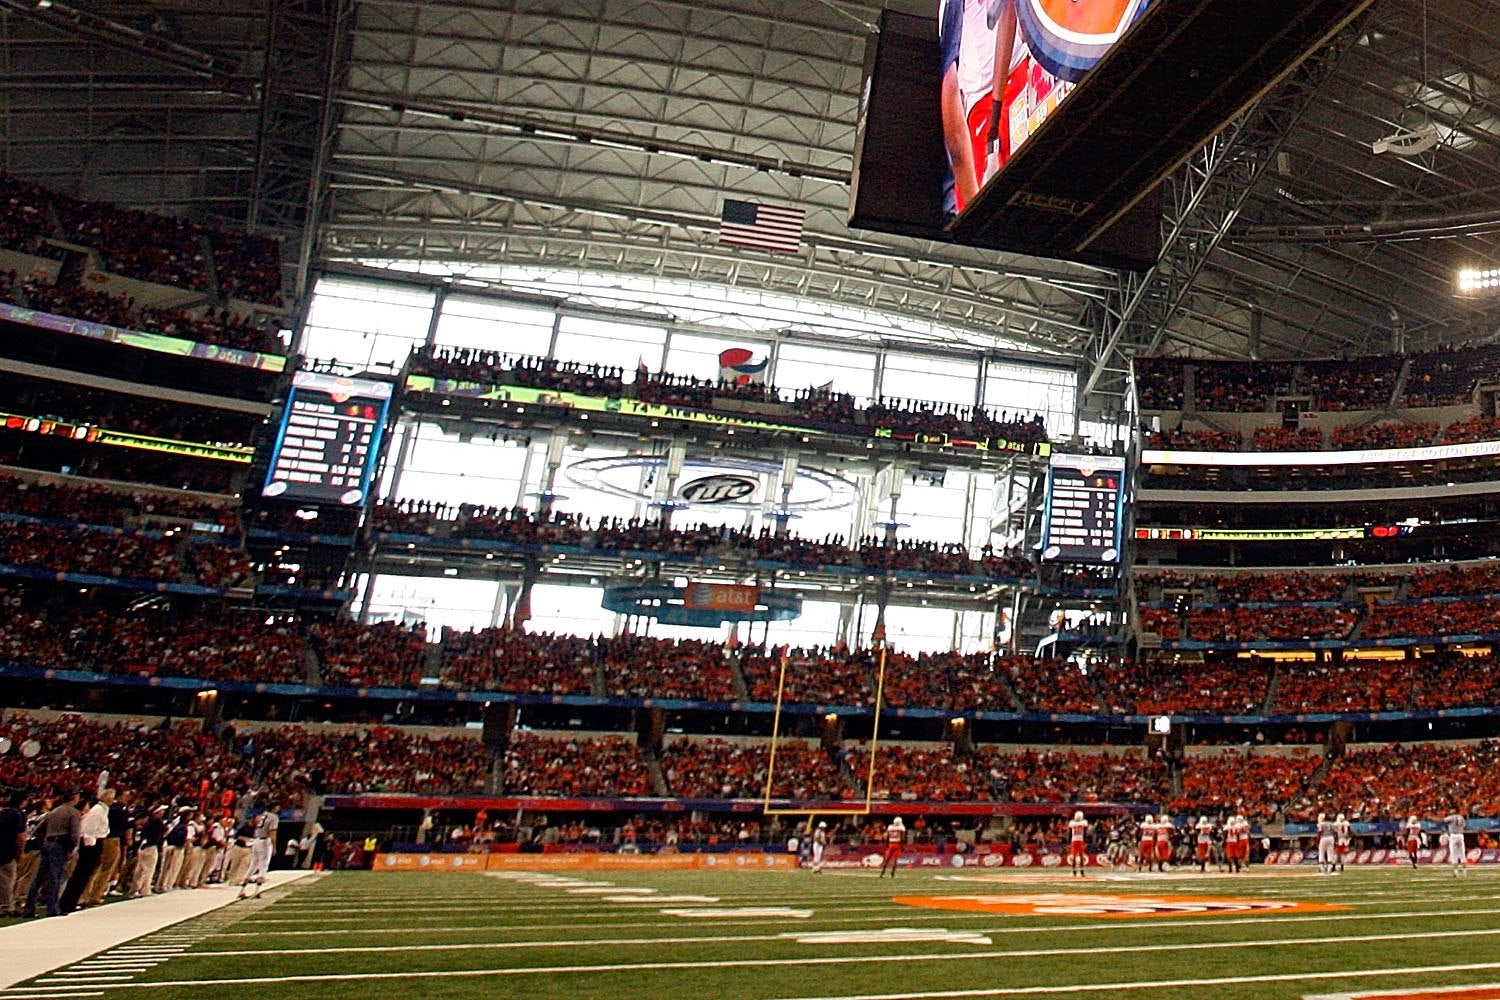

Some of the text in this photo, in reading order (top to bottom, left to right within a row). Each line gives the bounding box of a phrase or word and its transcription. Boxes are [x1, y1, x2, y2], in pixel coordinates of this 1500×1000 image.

[1006, 440, 1025, 452] at&t
[1419, 446, 1470, 459] COTTON
[716, 586, 750, 605] at&t
